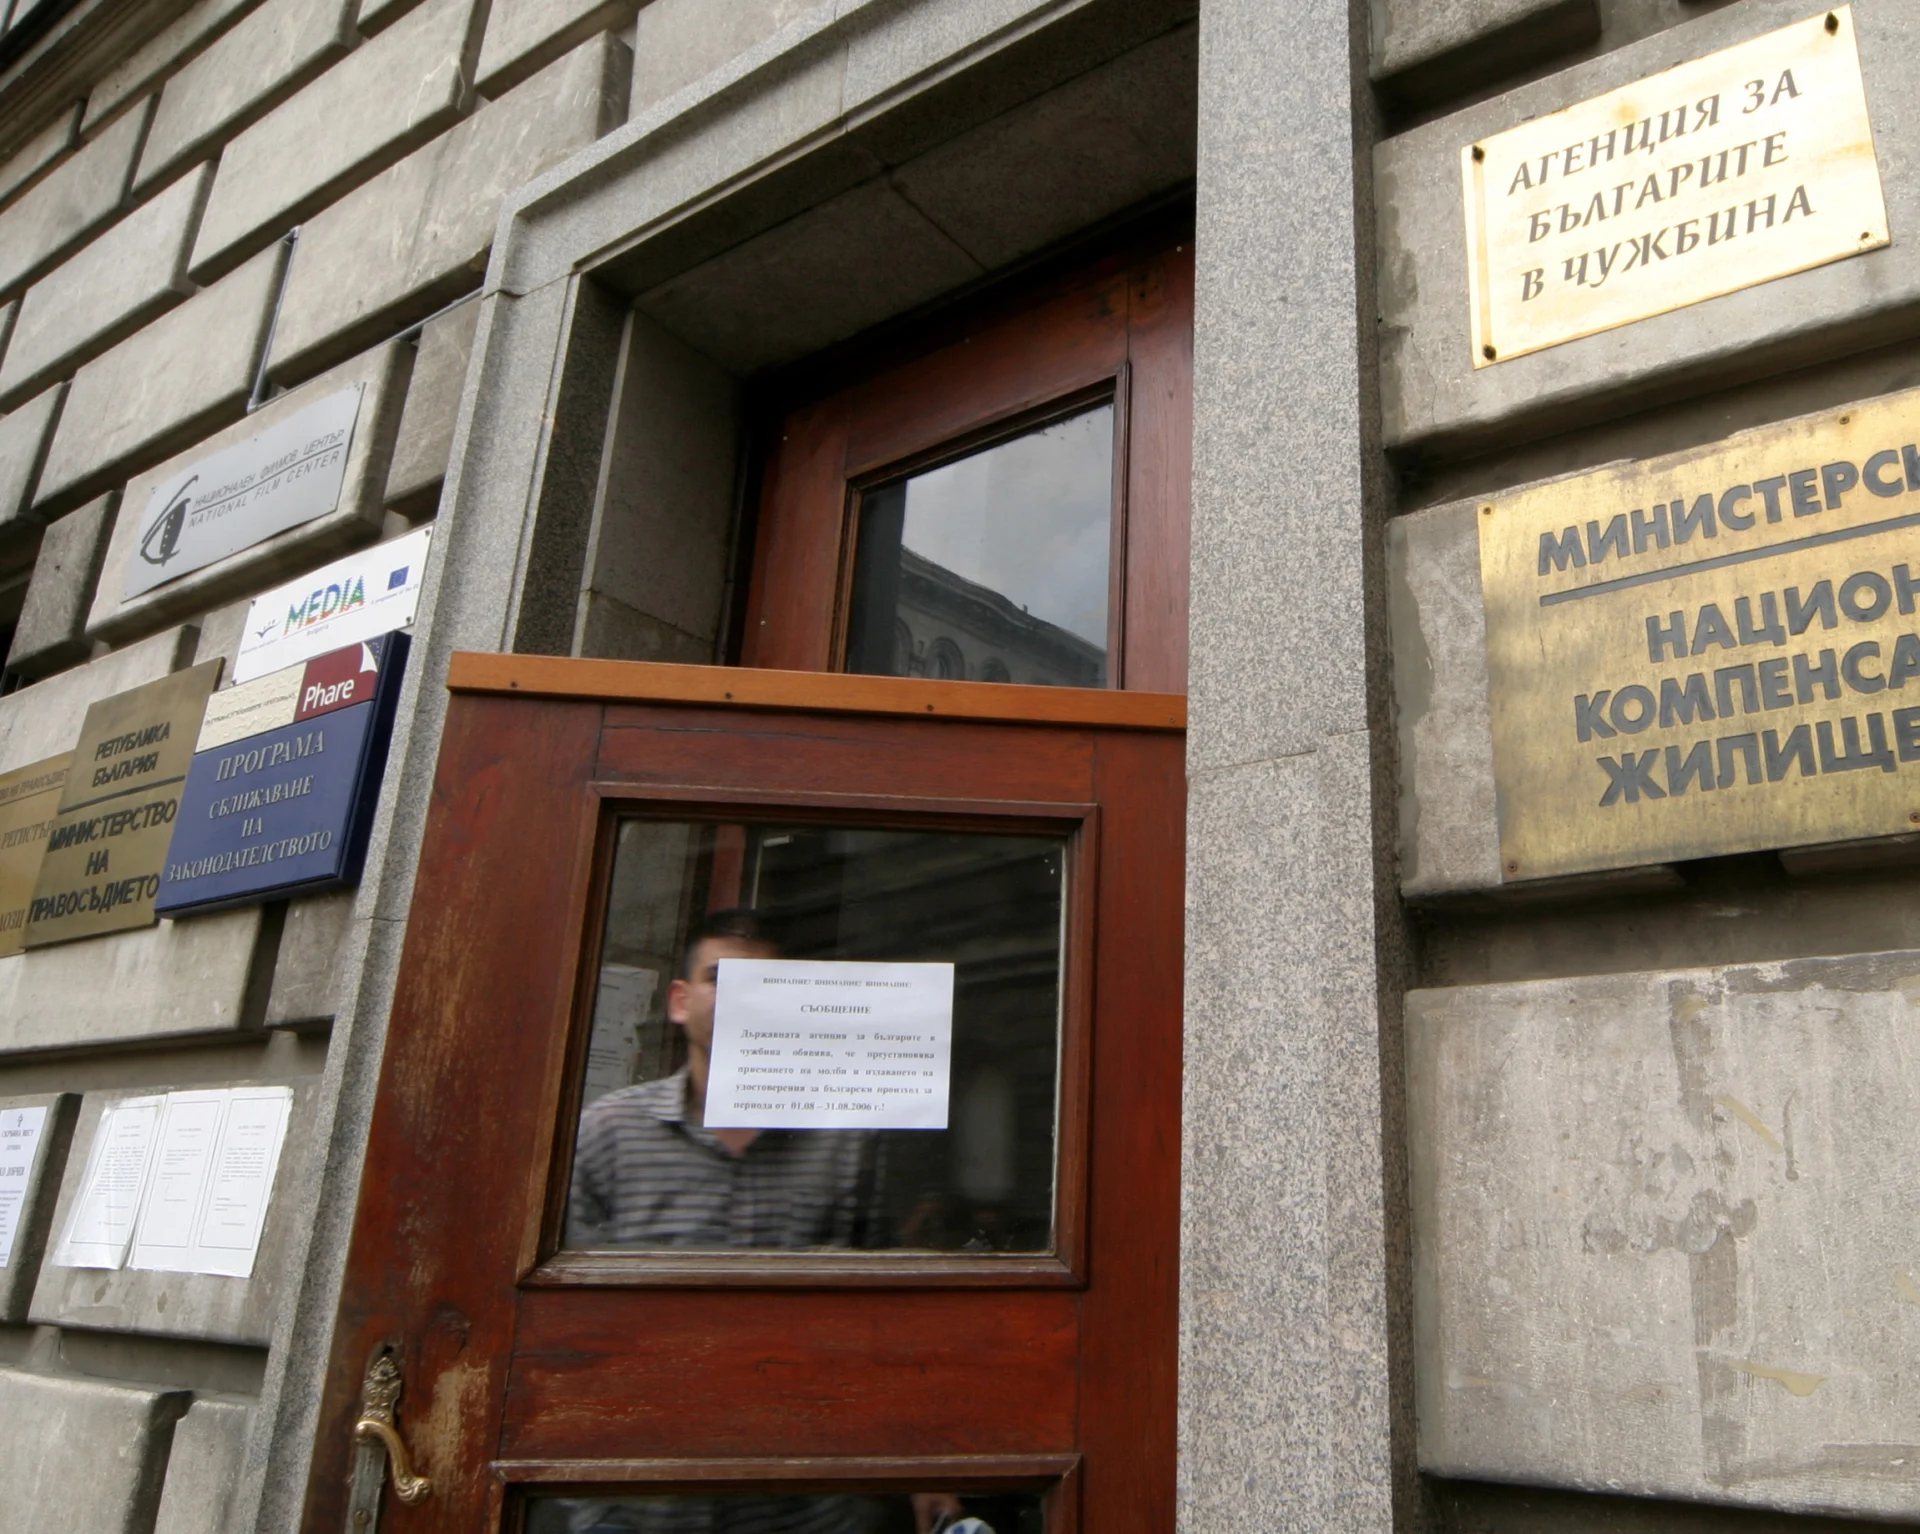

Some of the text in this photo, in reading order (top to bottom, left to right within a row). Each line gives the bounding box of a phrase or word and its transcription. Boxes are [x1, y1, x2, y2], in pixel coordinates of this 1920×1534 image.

[1507, 68, 1803, 197] АГЕНЦИЯ ЗА
[1527, 131, 1790, 244] БЪЛГАРИТЕ
[1520, 184, 1816, 302] В ЧУЖБИНА
[303, 429, 345, 456] ЦЕНТЪР
[188, 450, 340, 529] NATIONAL FILM CENTER
[283, 575, 366, 636] MEDIA
[302, 678, 356, 713] Phare
[1574, 633, 1920, 742] КОМПЕНСА
[95, 721, 171, 762] РЕПУБЛИКА
[215, 730, 325, 783] ПРОГРАМА
[1596, 705, 1920, 807] ЖИЛИЩЕ
[91, 750, 160, 789] БЪЛГАРИЯ
[209, 774, 314, 820] СБЛИЖАВАНЕ
[47, 798, 179, 853] МИНИСТЕРСТВО
[241, 816, 263, 839] НА
[84, 848, 110, 877] НА
[166, 829, 332, 883] ЗАКОНОДАТЕЛСТВОТО
[27, 872, 161, 924] ПРАВОСЪДИЕТО
[800, 1004, 872, 1015] СЪОБЩЕНИЕ
[740, 1029, 800, 1040] Държавната
[874, 1032, 922, 1043] българите
[740, 1048, 781, 1058] чужбина
[735, 1083, 806, 1094] удостоверения
[775, 1103, 786, 1111] от
[790, 1101, 815, 1112] 01.08
[824, 1101, 872, 1113] 31.08.2006
